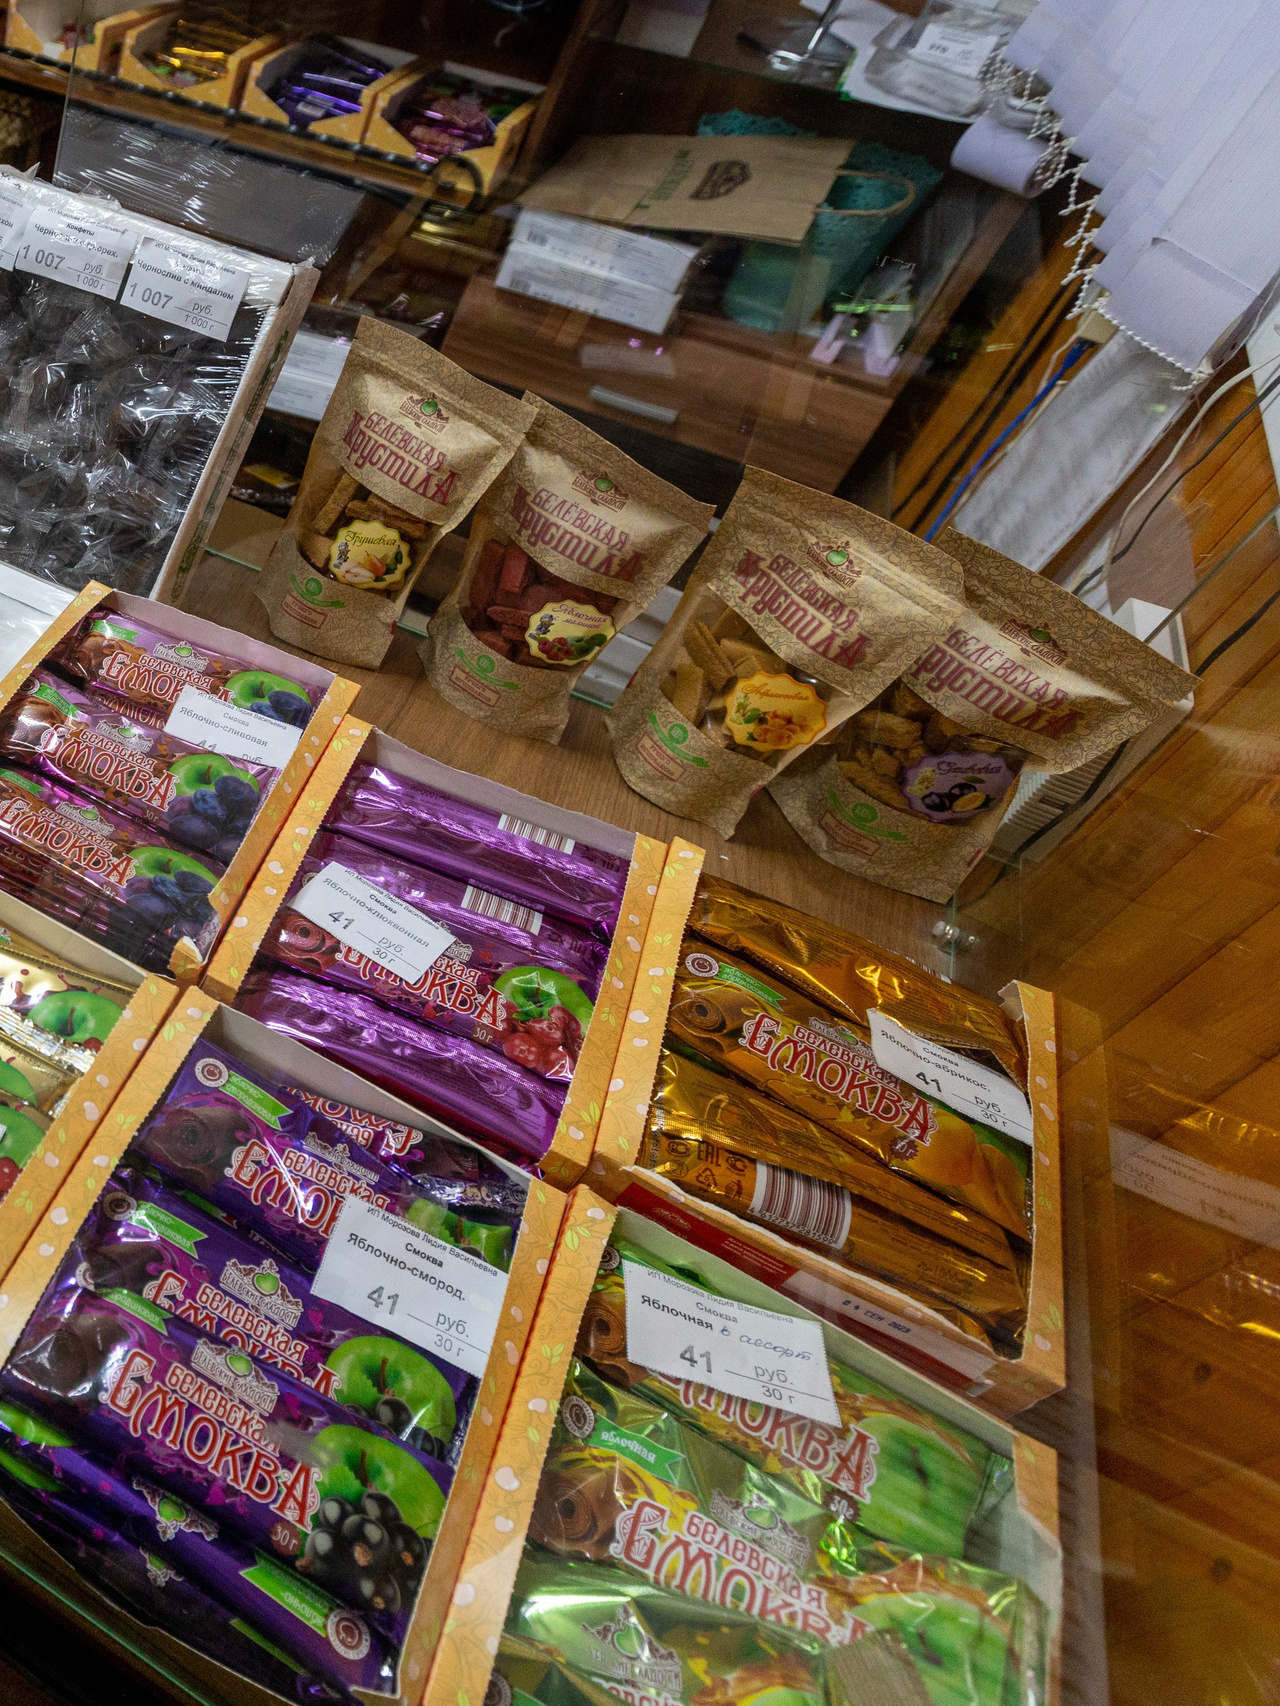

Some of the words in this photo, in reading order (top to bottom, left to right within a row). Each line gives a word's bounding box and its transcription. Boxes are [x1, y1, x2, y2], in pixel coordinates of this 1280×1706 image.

[67, 223, 95, 236] Конфеты
[35, 249, 65, 269] 007
[83, 262, 104, 275] руб.
[137, 259, 182, 282] Чернослив
[142, 288, 173, 309] 007
[192, 302, 213, 316] руб.
[364, 411, 447, 471] БЕЛЁВСКАЯ
[531, 488, 629, 551] БЕЛЁВСКАЯ
[345, 529, 397, 549] Грушевая
[767, 553, 859, 632] БЕЛЁВСКАЯ
[552, 604, 609, 623] Яблочная
[562, 617, 601, 630] малиной
[945, 629, 1069, 710] БЕЛЁВСКАЯ
[198, 691, 207, 700] ИП
[208, 696, 236, 710] Морозова
[237, 706, 253, 717] Лидия
[253, 712, 287, 731] Васильевна
[223, 712, 250, 728] Смоква
[180, 706, 268, 748] Яблочно-сливовая
[41, 724, 179, 812] СМОКВА
[356, 874, 386, 896] Морозова
[384, 891, 403, 907] Лидия
[404, 904, 440, 931] Васильевна
[369, 894, 397, 915] Смоква
[328, 911, 355, 930] 41
[372, 948, 389, 960] 30
[379, 936, 405, 956] руб.
[473, 1027, 486, 1041] 30
[881, 1030, 991, 1091] Яблочно-абрикос.
[923, 1047, 959, 1067] Смоква
[739, 1012, 938, 1146] СМОКВА
[916, 1072, 942, 1093] 41
[975, 1096, 1006, 1115] руб.
[981, 1110, 998, 1123] 30
[367, 1206, 380, 1218] ИП
[381, 1213, 420, 1239] Морозова
[421, 1233, 447, 1252] Лидия
[449, 1247, 498, 1277] Васильевна
[405, 1242, 444, 1268] Смоква
[347, 1233, 465, 1301] Яблочно-смород.
[222, 1268, 260, 1306] БЕЛЕВСКИЕ
[259, 1298, 301, 1328] СЛАДОСТИ
[367, 1286, 399, 1315] 41
[647, 1270, 661, 1281] ИП
[663, 1275, 705, 1298] Морозова
[707, 1294, 735, 1308] Лидия
[737, 1303, 794, 1324] Васильевна
[196, 1283, 309, 1365] БЕЛЕВСКАЯ
[641, 1295, 714, 1331] Яблочная
[696, 1302, 739, 1324] Смоква
[436, 1312, 469, 1338] руб.
[434, 1334, 454, 1352] 30
[679, 1345, 713, 1374] 41
[192, 1347, 234, 1386] БЕЛЕВСКИЕ
[233, 1378, 278, 1413] СЛАДОСТИ
[754, 1364, 794, 1385] руб.
[762, 1385, 782, 1401] 30
[99, 1349, 323, 1533] СМОКВА
[600, 1430, 657, 1464] яблочная
[271, 1523, 290, 1541] 30
